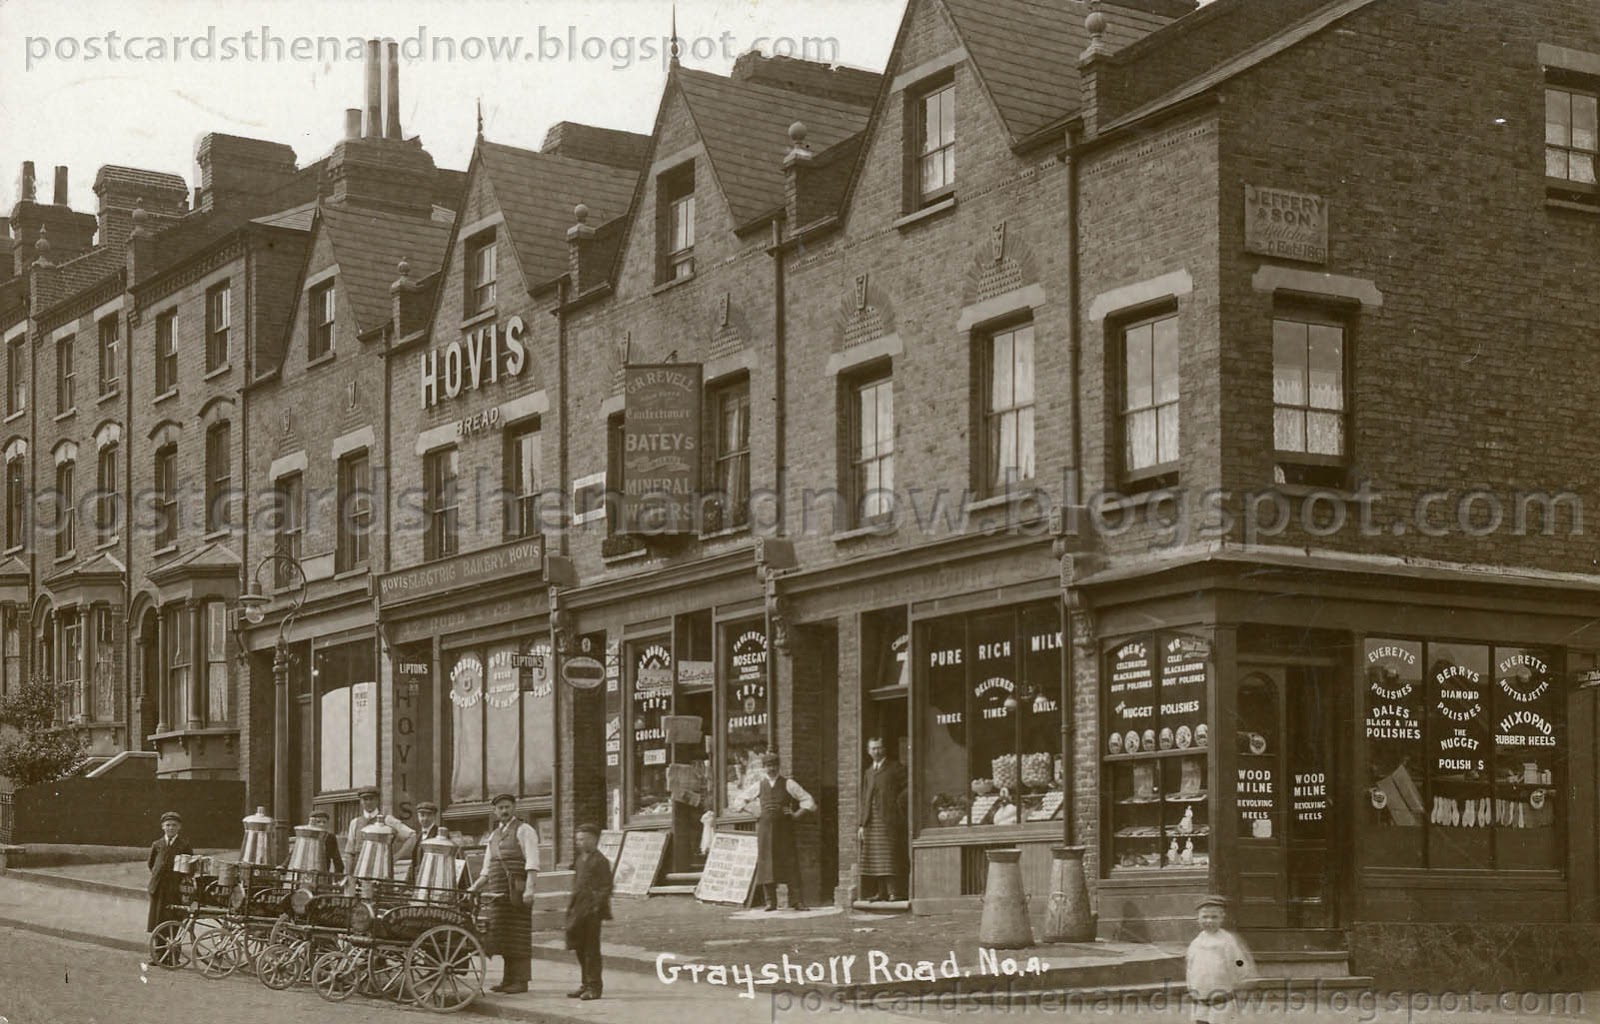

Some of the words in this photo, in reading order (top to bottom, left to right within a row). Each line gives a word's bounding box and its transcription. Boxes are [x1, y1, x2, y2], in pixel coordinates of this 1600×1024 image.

[421, 315, 525, 410] HOVIS
[646, 370, 693, 393] REVELL
[456, 406, 500, 435] BREAD
[625, 478, 691, 496] MINERAL
[625, 502, 690, 521] WATERS
[381, 577, 408, 594] HOVIS
[509, 544, 540, 564] HOVIS
[930, 648, 962, 667] PURE
[978, 640, 1011, 660] RICH
[1031, 632, 1063, 652] MILK
[1368, 646, 1416, 665] EVERETTS
[512, 655, 543, 668] LIPTONS
[733, 651, 767, 667] NOSEGAY
[1500, 654, 1548, 674] EVERETTS
[399, 663, 428, 675] LIPTONS
[1436, 665, 1480, 684] BERRYS
[974, 677, 1014, 698] DELIVERED
[1162, 677, 1177, 686] BOOT
[1178, 674, 1205, 684] POLISHES
[1371, 682, 1413, 700] POLISHES
[1441, 689, 1479, 700] DIAMOND
[936, 712, 962, 725] THREE
[983, 706, 1008, 719] TIMES
[1122, 705, 1153, 719] NUGGET
[1160, 700, 1199, 715] POLISHES
[1373, 704, 1410, 719] DALES
[1437, 701, 1482, 721] POLISHES
[1366, 718, 1391, 727] BLACK
[1395, 719, 1401, 727] &
[1500, 710, 1552, 735] HIXOPAD
[1366, 727, 1421, 740] POLISHES
[1453, 728, 1467, 737] THE
[1440, 737, 1479, 751] NUGGET
[1495, 734, 1526, 746] RUBBER
[1528, 735, 1556, 747] HEELS
[1238, 769, 1271, 780] WOOD
[1295, 773, 1325, 784] WOOD
[1237, 782, 1273, 793] MILNE
[1294, 785, 1326, 796] MILNE
[1237, 799, 1273, 808] REVOLVING
[1294, 801, 1326, 810] REVOLVING
[1242, 811, 1269, 819] HEELS
[1298, 812, 1322, 821] HEELS
